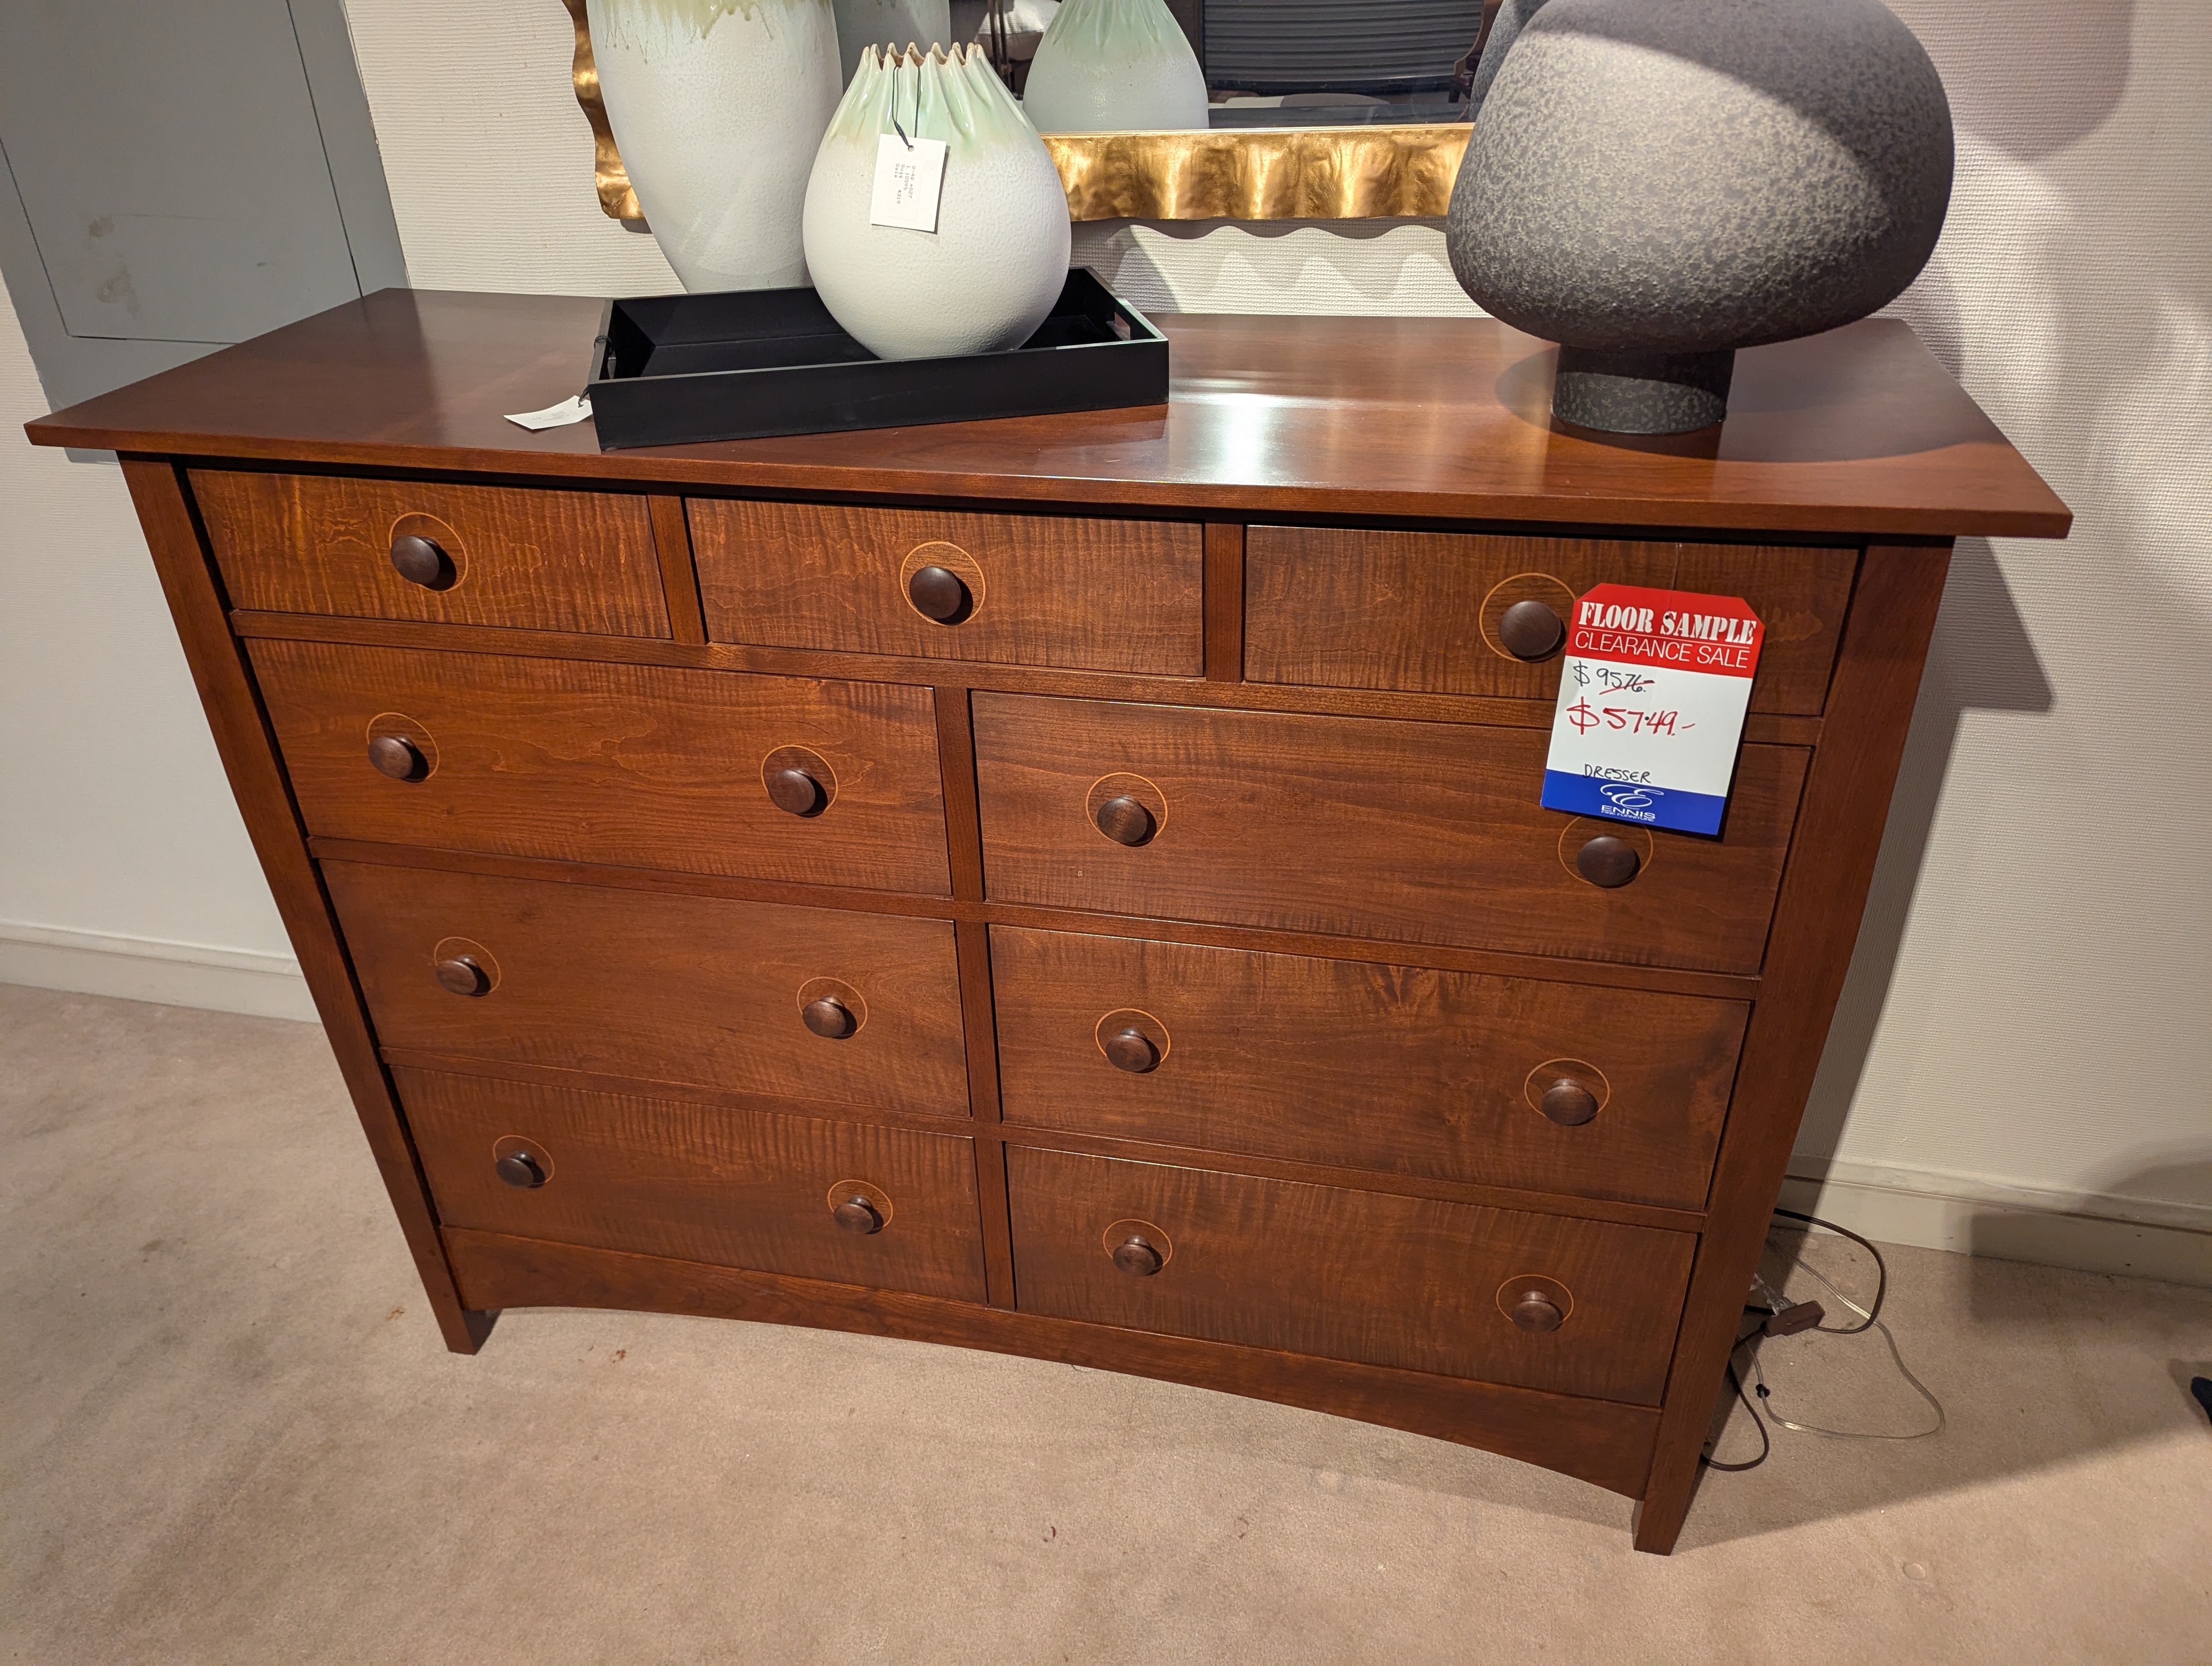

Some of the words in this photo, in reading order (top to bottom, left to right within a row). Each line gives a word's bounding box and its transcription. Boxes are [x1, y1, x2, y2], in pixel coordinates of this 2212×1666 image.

[1578, 601, 1654, 633] FLOOR
[1660, 610, 1757, 645] SAMPLE
[1575, 631, 1693, 662] CLEARANCE
[1697, 645, 1751, 668] SALE
[1583, 764, 1651, 783] DRESSER
[1601, 804, 1656, 819] ENNIS
